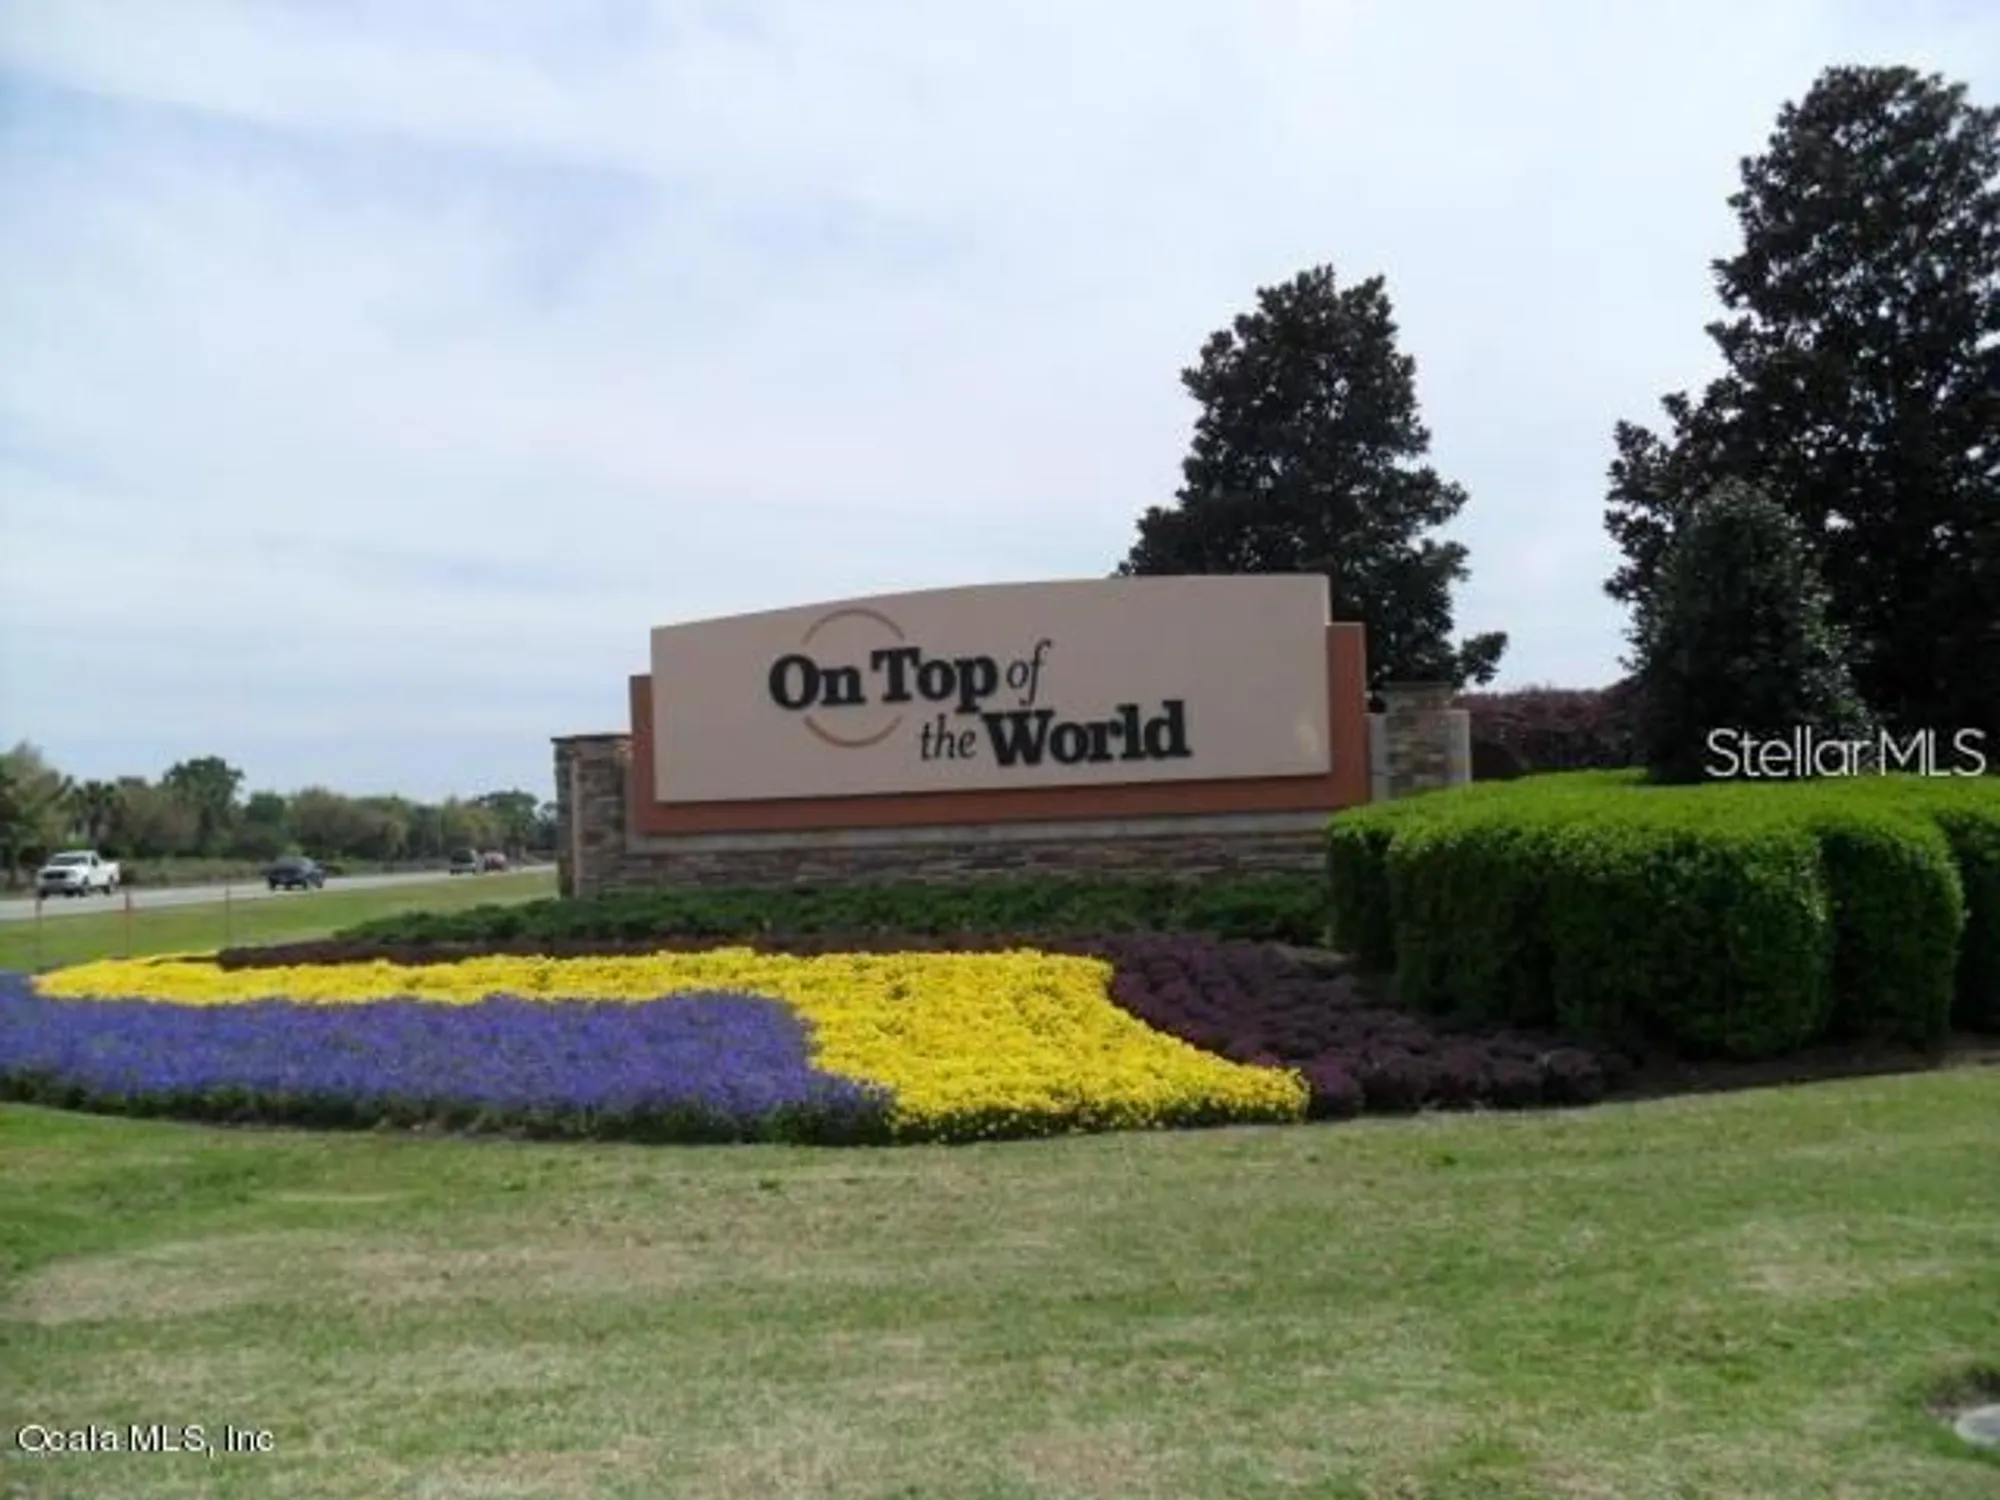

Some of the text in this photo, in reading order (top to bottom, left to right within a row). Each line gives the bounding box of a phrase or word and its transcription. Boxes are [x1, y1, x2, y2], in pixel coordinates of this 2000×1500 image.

[769, 638, 1052, 713] On Top of
[920, 699, 1192, 766] the World
